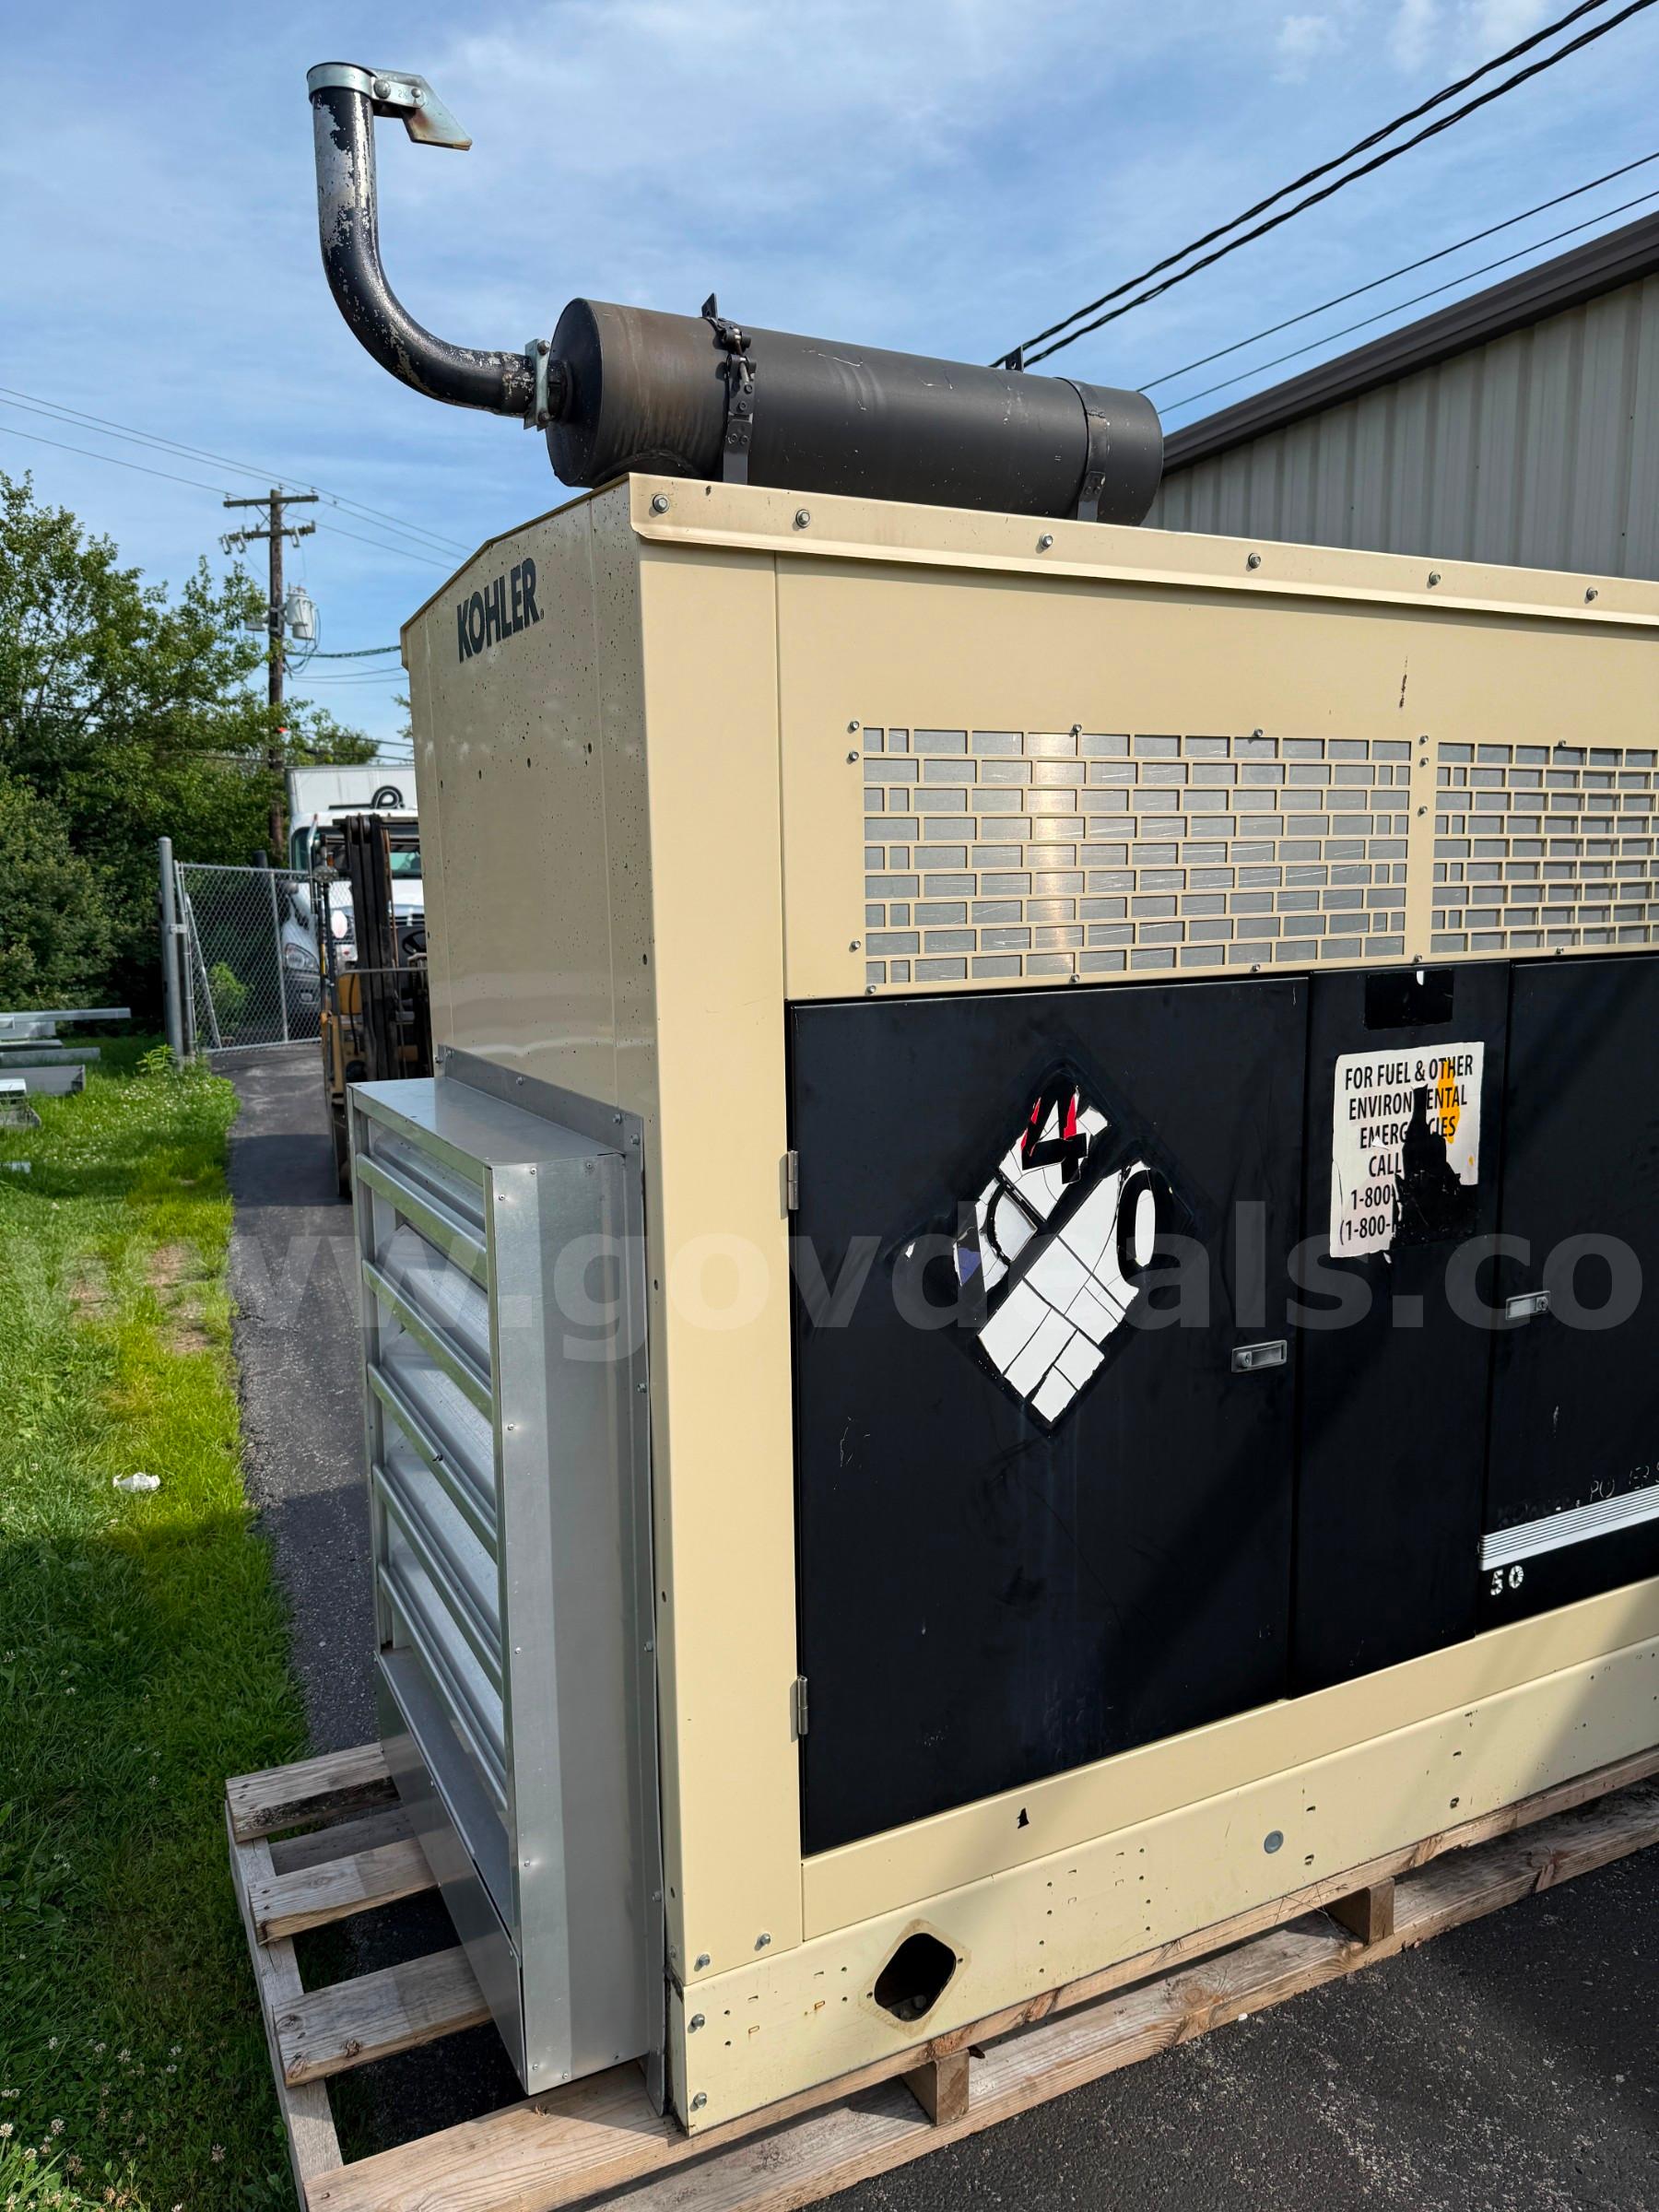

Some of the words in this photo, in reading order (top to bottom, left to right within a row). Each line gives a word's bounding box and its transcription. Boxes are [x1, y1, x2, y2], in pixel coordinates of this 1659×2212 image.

[1345, 1065, 1373, 1090] FOR
[1377, 1061, 1411, 1087] FUEL
[1414, 1060, 1426, 1082] &
[1429, 1054, 1474, 1080] OTHER
[1368, 1152, 1402, 1178] CALL
